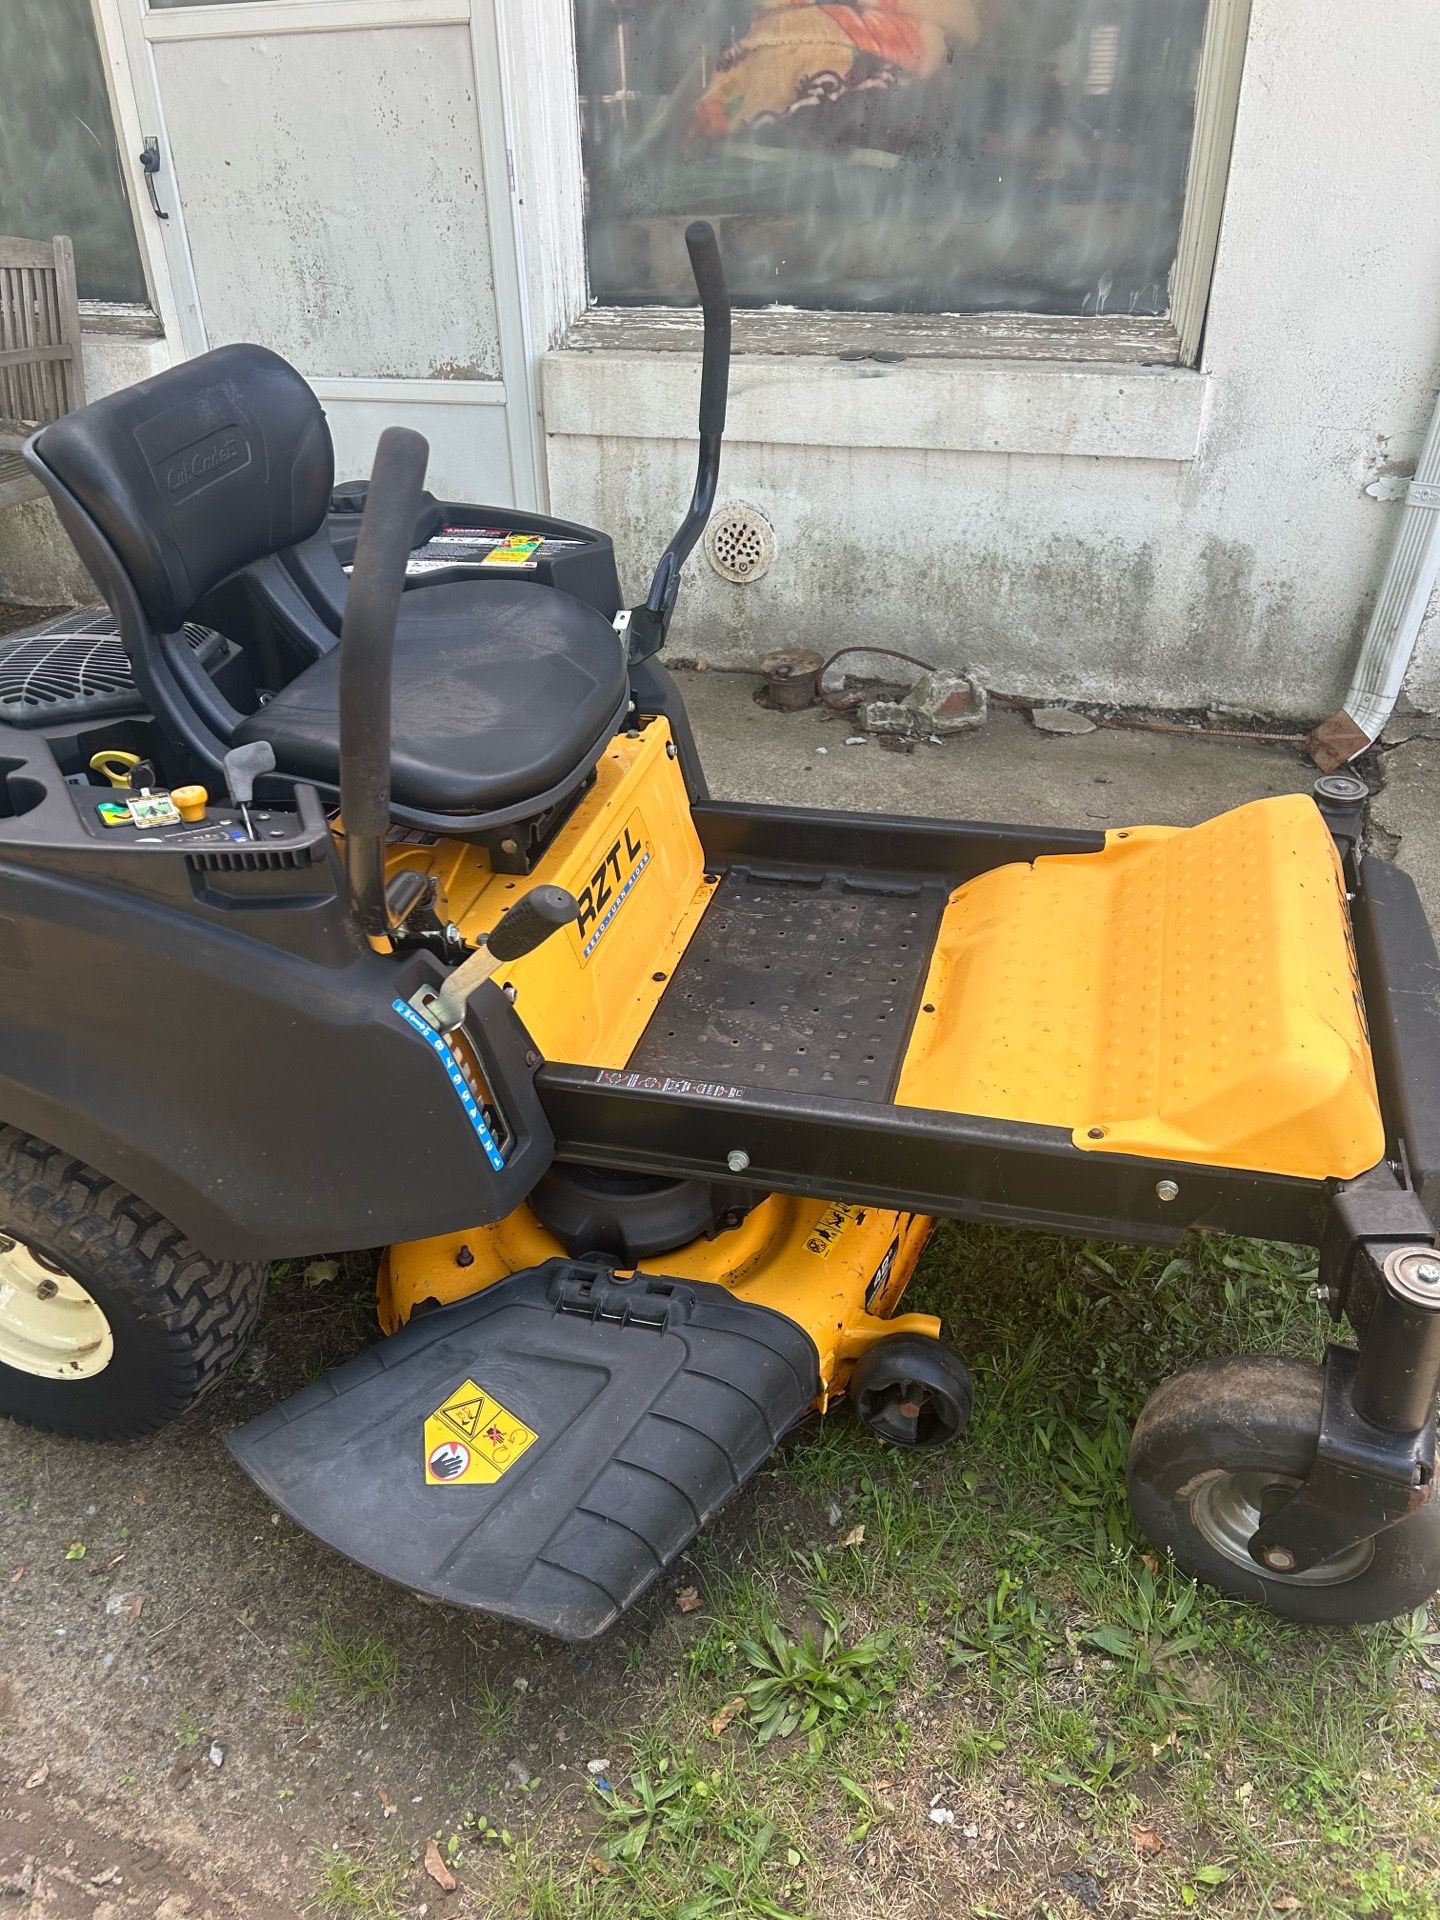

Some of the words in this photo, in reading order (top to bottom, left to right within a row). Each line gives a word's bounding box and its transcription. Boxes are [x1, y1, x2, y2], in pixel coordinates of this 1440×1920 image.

[628, 854, 650, 887] RIDER
[434, 1039, 445, 1050] 8
[446, 1057, 453, 1069] 7
[453, 1073, 462, 1085] 6
[462, 1090, 471, 1101] 5
[469, 1107, 478, 1118] 4
[477, 1123, 487, 1134] 3
[483, 1140, 493, 1151] 2
[493, 1157, 501, 1166] 1
